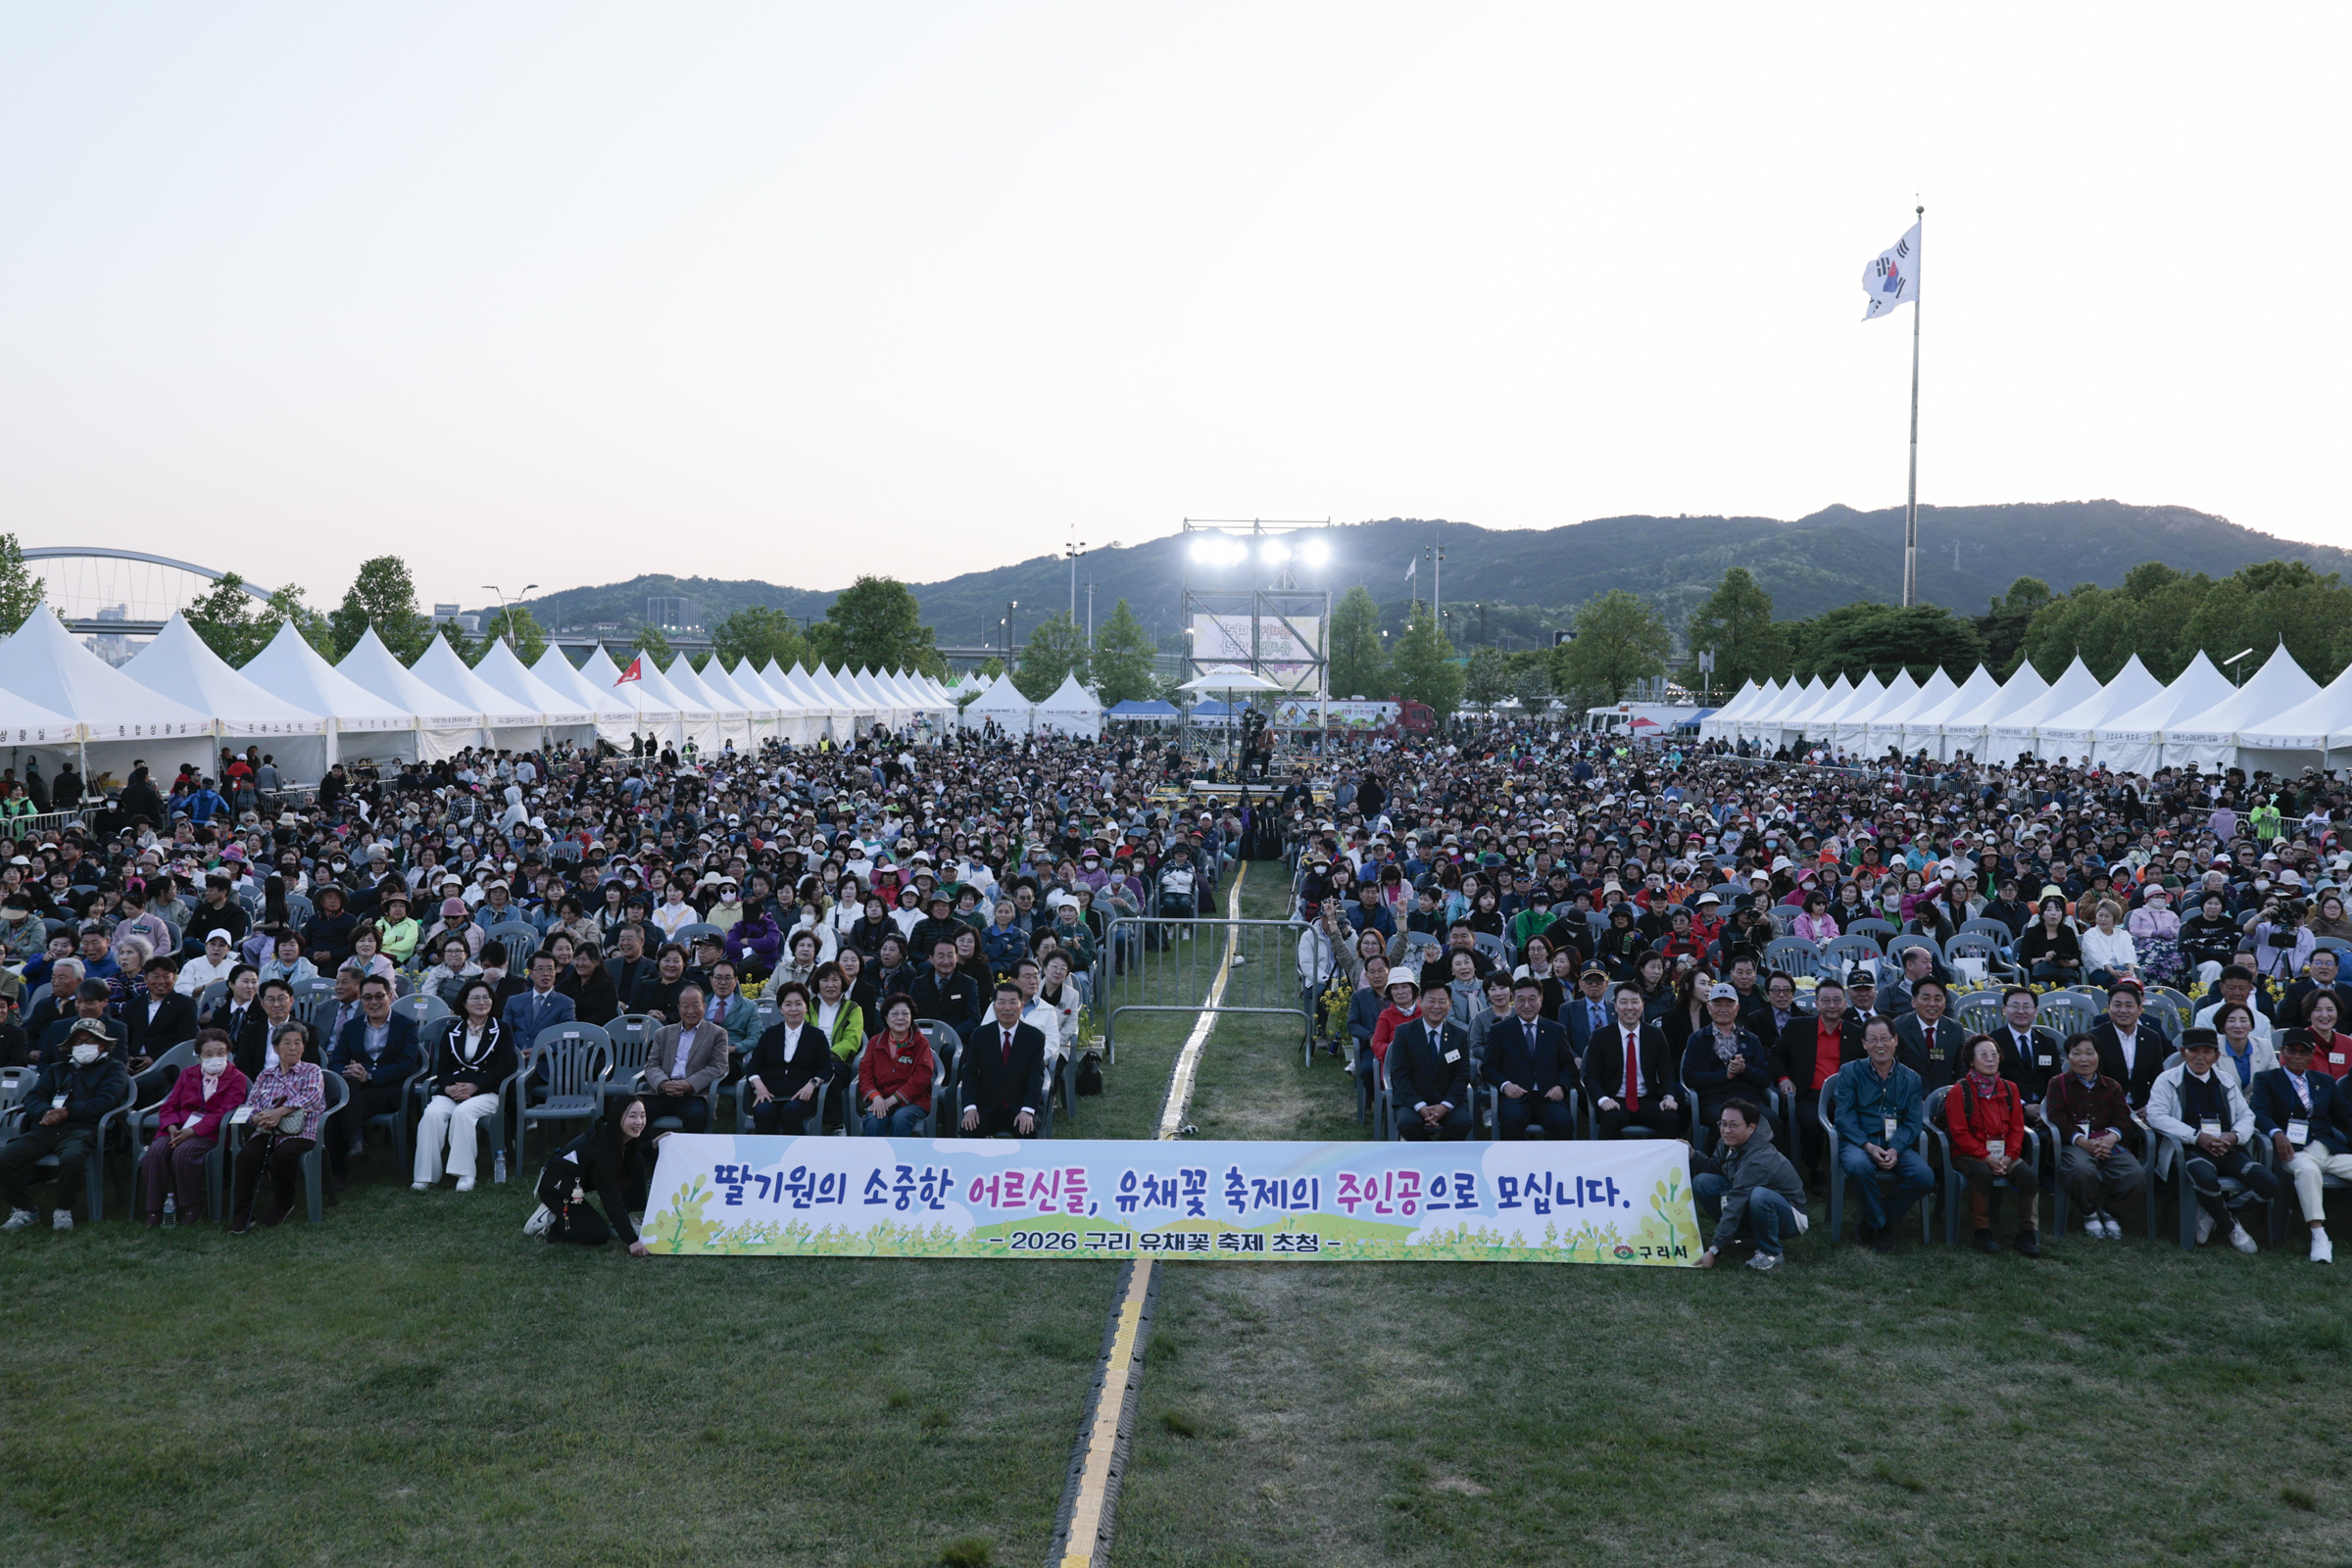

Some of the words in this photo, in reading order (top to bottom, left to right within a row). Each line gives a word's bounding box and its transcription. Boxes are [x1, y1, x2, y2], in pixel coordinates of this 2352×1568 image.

[0, 728, 44, 742] 상황실
[119, 723, 185, 737] 종합상황실
[714, 1164, 847, 1209] 딸기원의
[863, 1165, 955, 1210] 소중한
[968, 1168, 1098, 1216] 어르신들,
[1115, 1168, 1207, 1217] 유채꽃
[1225, 1166, 1319, 1214] 축제의
[1338, 1171, 1479, 1215] 주인공으로
[1497, 1171, 1631, 1215] 모십니다.
[1010, 1232, 1077, 1250] 2026
[1084, 1232, 1131, 1251] 구리
[1138, 1233, 1211, 1252] 유채꽃
[1217, 1233, 1264, 1252] 축제
[1272, 1233, 1320, 1253] 초청
[1639, 1245, 1688, 1259] 구리시
